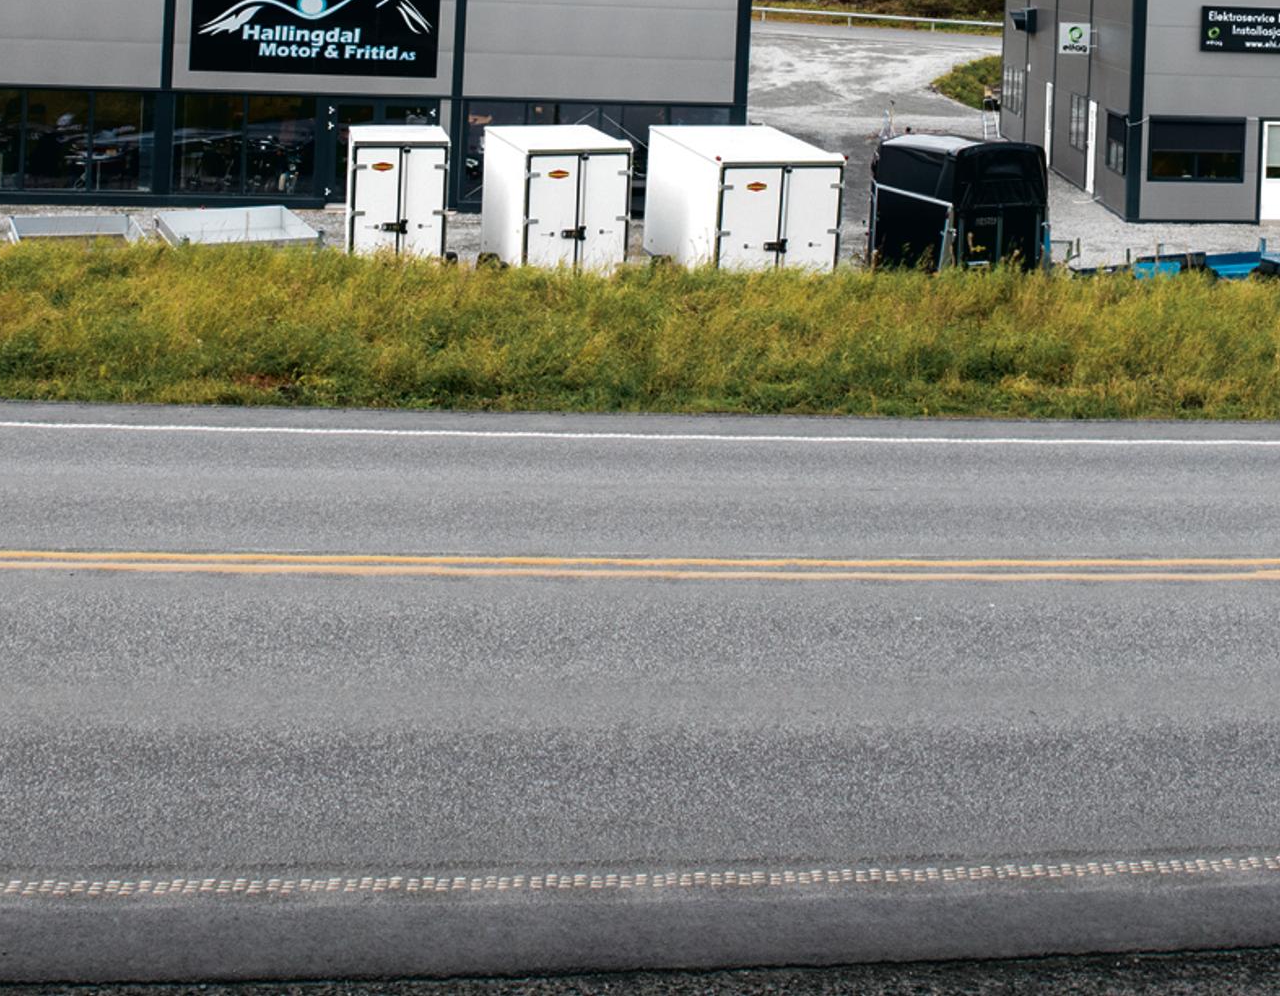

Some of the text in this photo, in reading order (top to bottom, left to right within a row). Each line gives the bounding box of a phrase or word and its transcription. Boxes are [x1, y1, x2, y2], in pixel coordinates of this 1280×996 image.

[1208, 10, 1275, 23] Elektroservice
[242, 24, 361, 46] Hallingdal
[259, 42, 416, 61] Motor & Fritid AS
